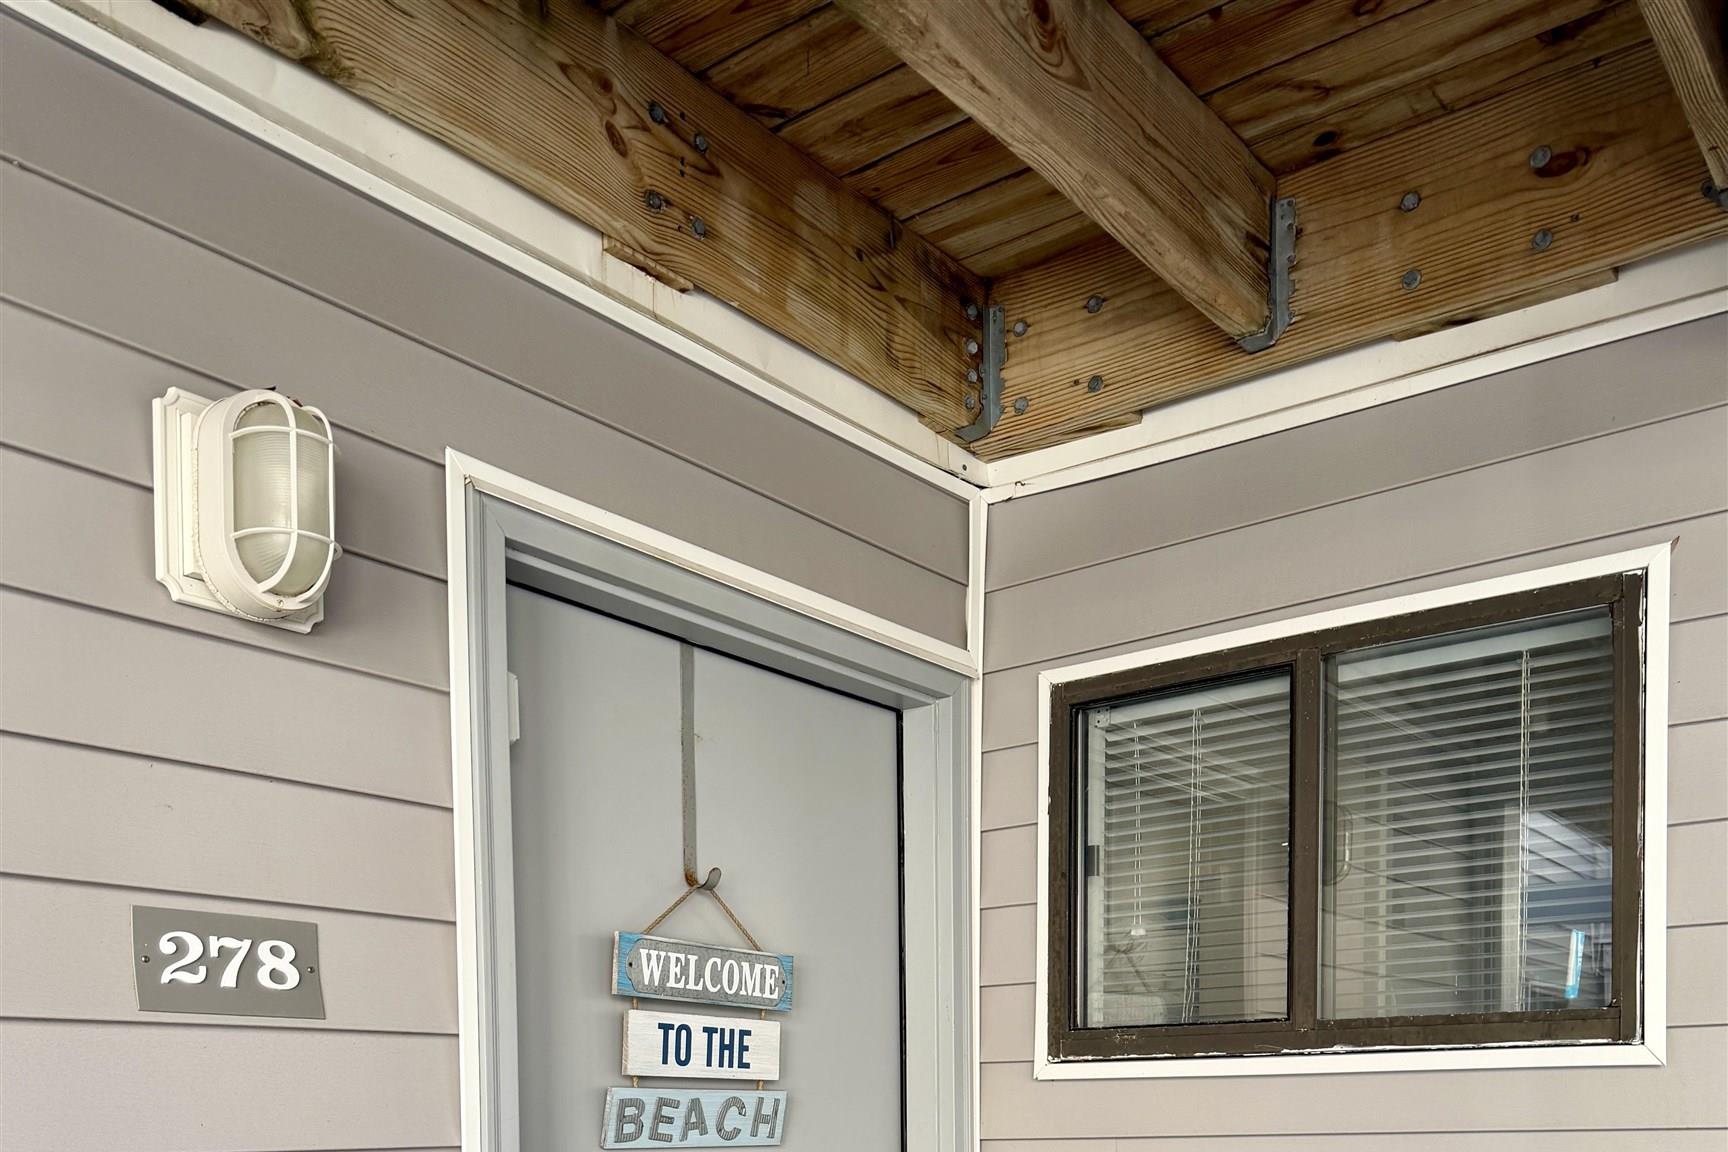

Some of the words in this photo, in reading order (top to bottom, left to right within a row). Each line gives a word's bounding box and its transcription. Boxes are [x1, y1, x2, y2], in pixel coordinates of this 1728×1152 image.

[159, 931, 300, 990] 278
[639, 948, 779, 999] WELCOME
[657, 1022, 692, 1067] TO
[702, 1026, 752, 1070] THE
[614, 1096, 780, 1143] BEACH
